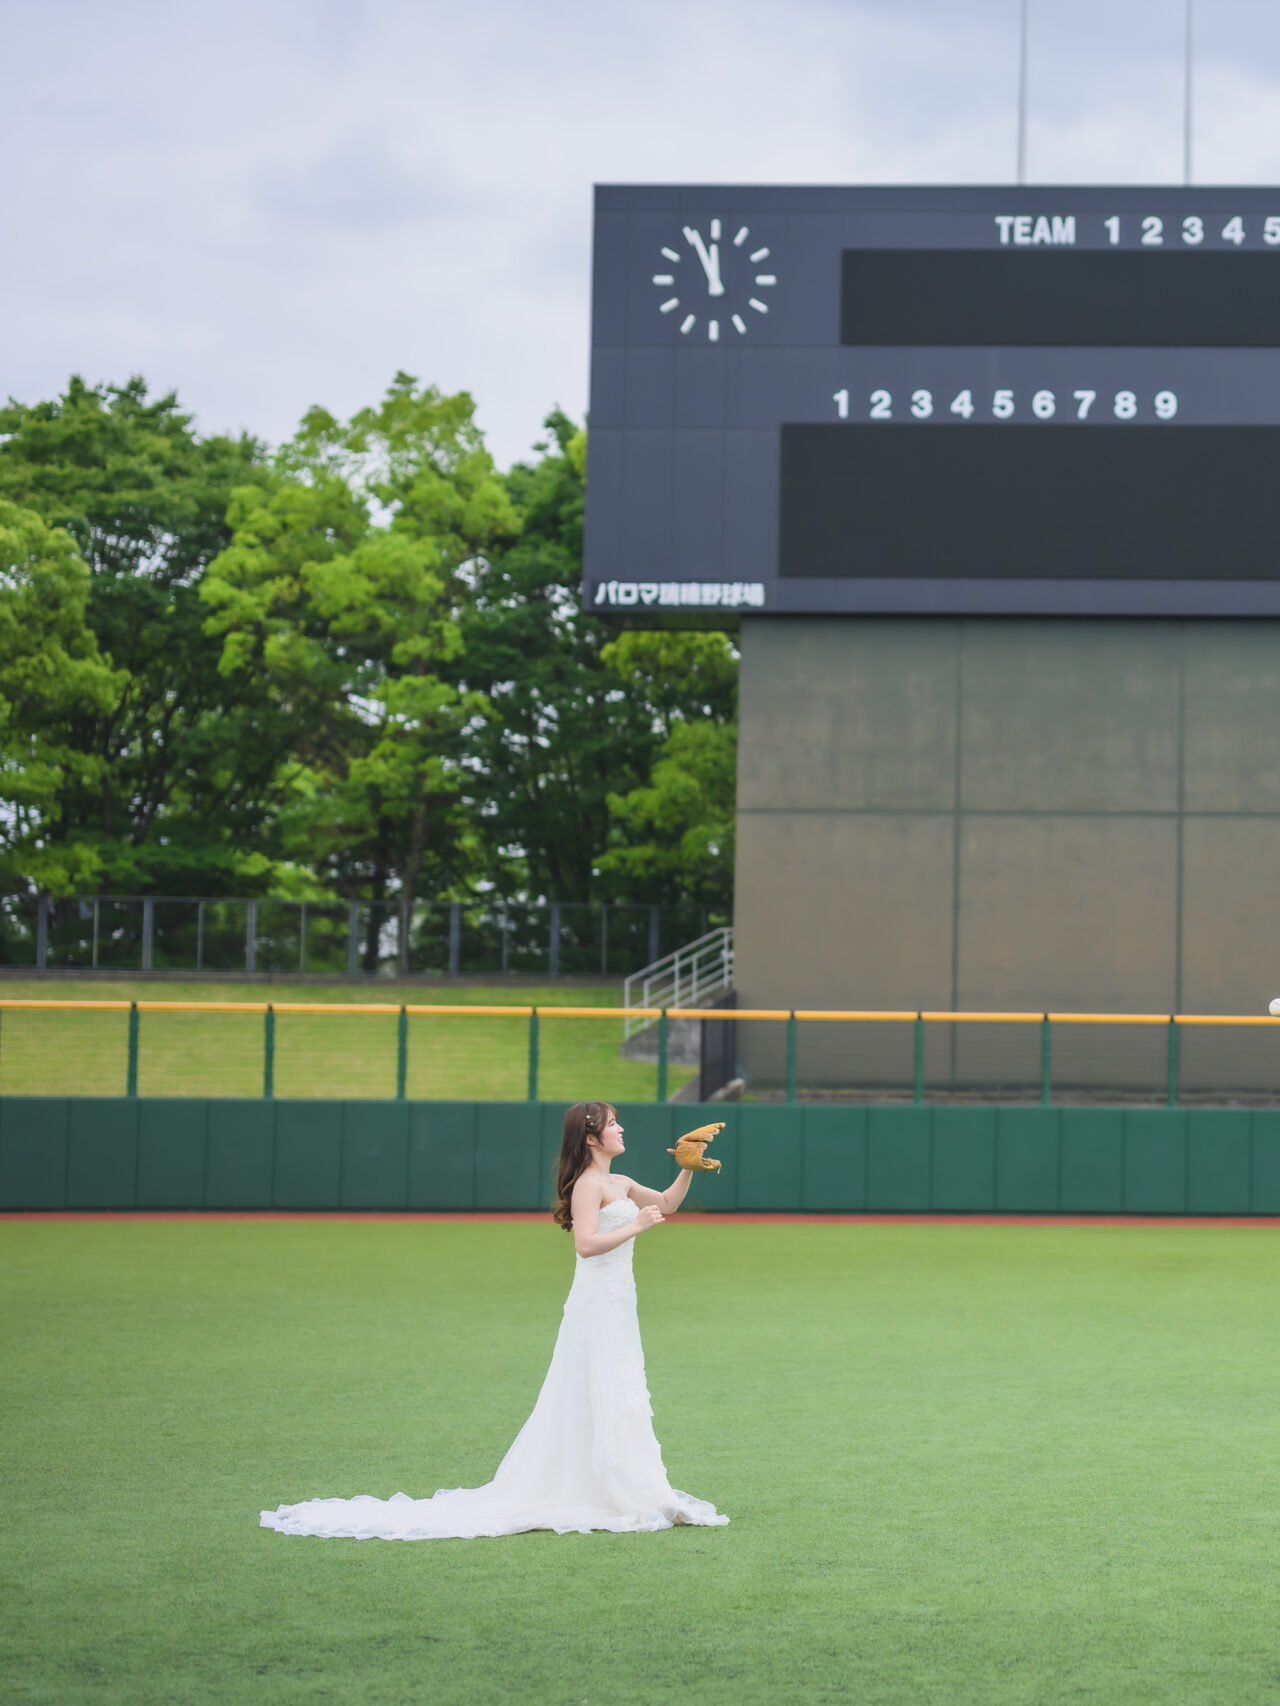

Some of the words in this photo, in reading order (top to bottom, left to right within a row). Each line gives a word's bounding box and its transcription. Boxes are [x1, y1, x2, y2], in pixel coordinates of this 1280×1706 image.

[994, 215, 1076, 245] TEAM
[1103, 215, 1120, 246] 1
[1140, 215, 1164, 246] 2
[1181, 215, 1205, 246] 3
[1221, 215, 1246, 246] 4
[832, 388, 849, 419] 1
[869, 389, 893, 419] 2
[910, 389, 934, 419] 3
[950, 389, 975, 419] 4
[991, 389, 1015, 419] 5
[1031, 389, 1056, 420] 6
[1073, 389, 1097, 420] 7
[1113, 390, 1138, 420] 8
[1154, 390, 1178, 420] 9
